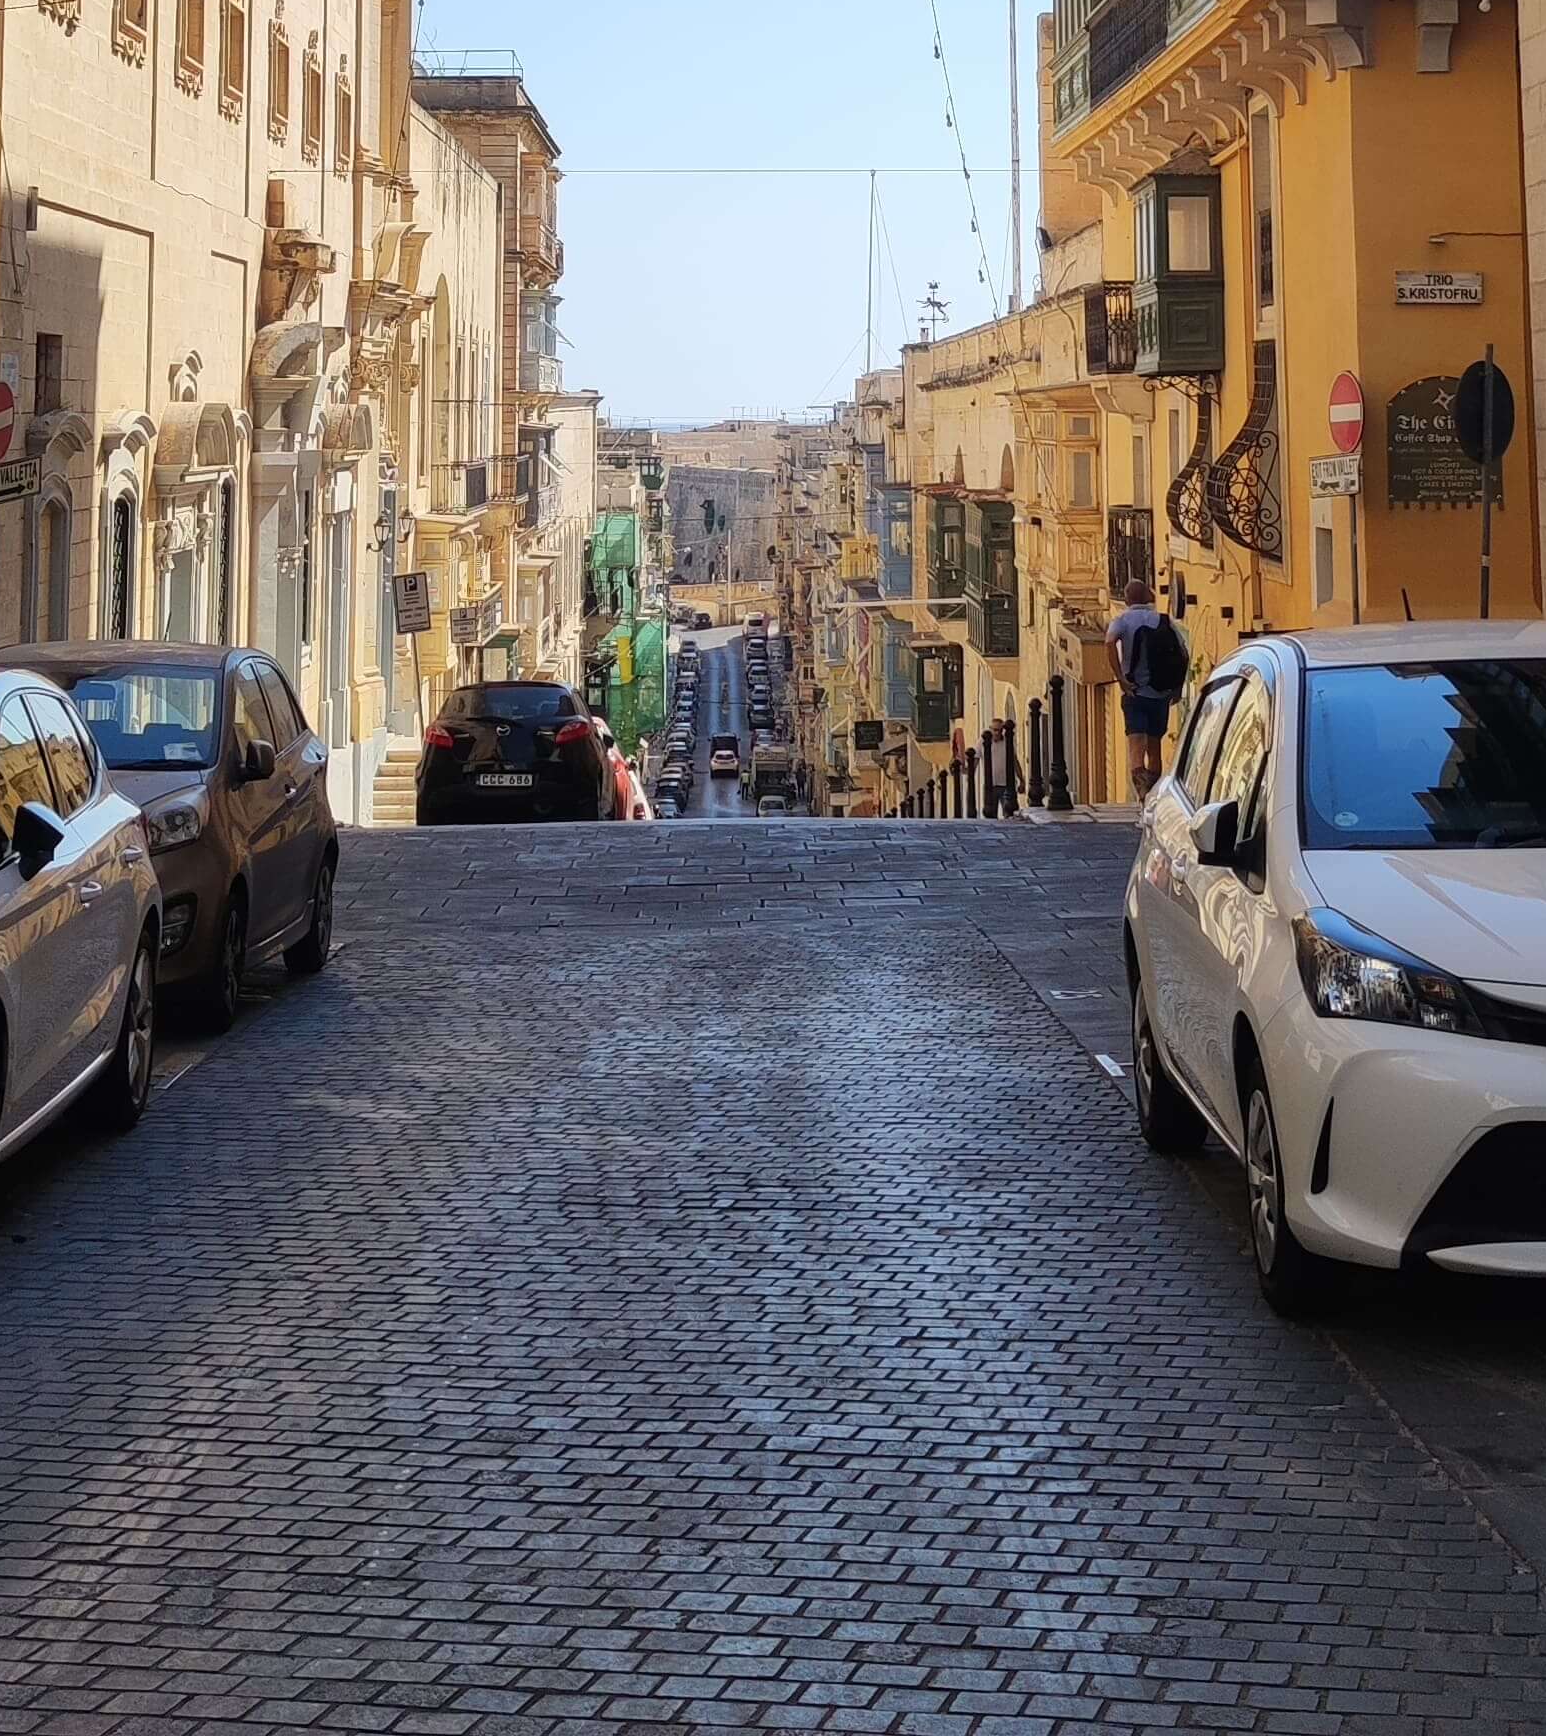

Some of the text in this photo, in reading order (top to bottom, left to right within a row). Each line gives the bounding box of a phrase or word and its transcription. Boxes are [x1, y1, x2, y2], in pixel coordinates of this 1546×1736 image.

[1396, 414, 1428, 432] The
[1394, 433, 1452, 444] Coffee Shop
[0, 462, 38, 484] VALLETTA
